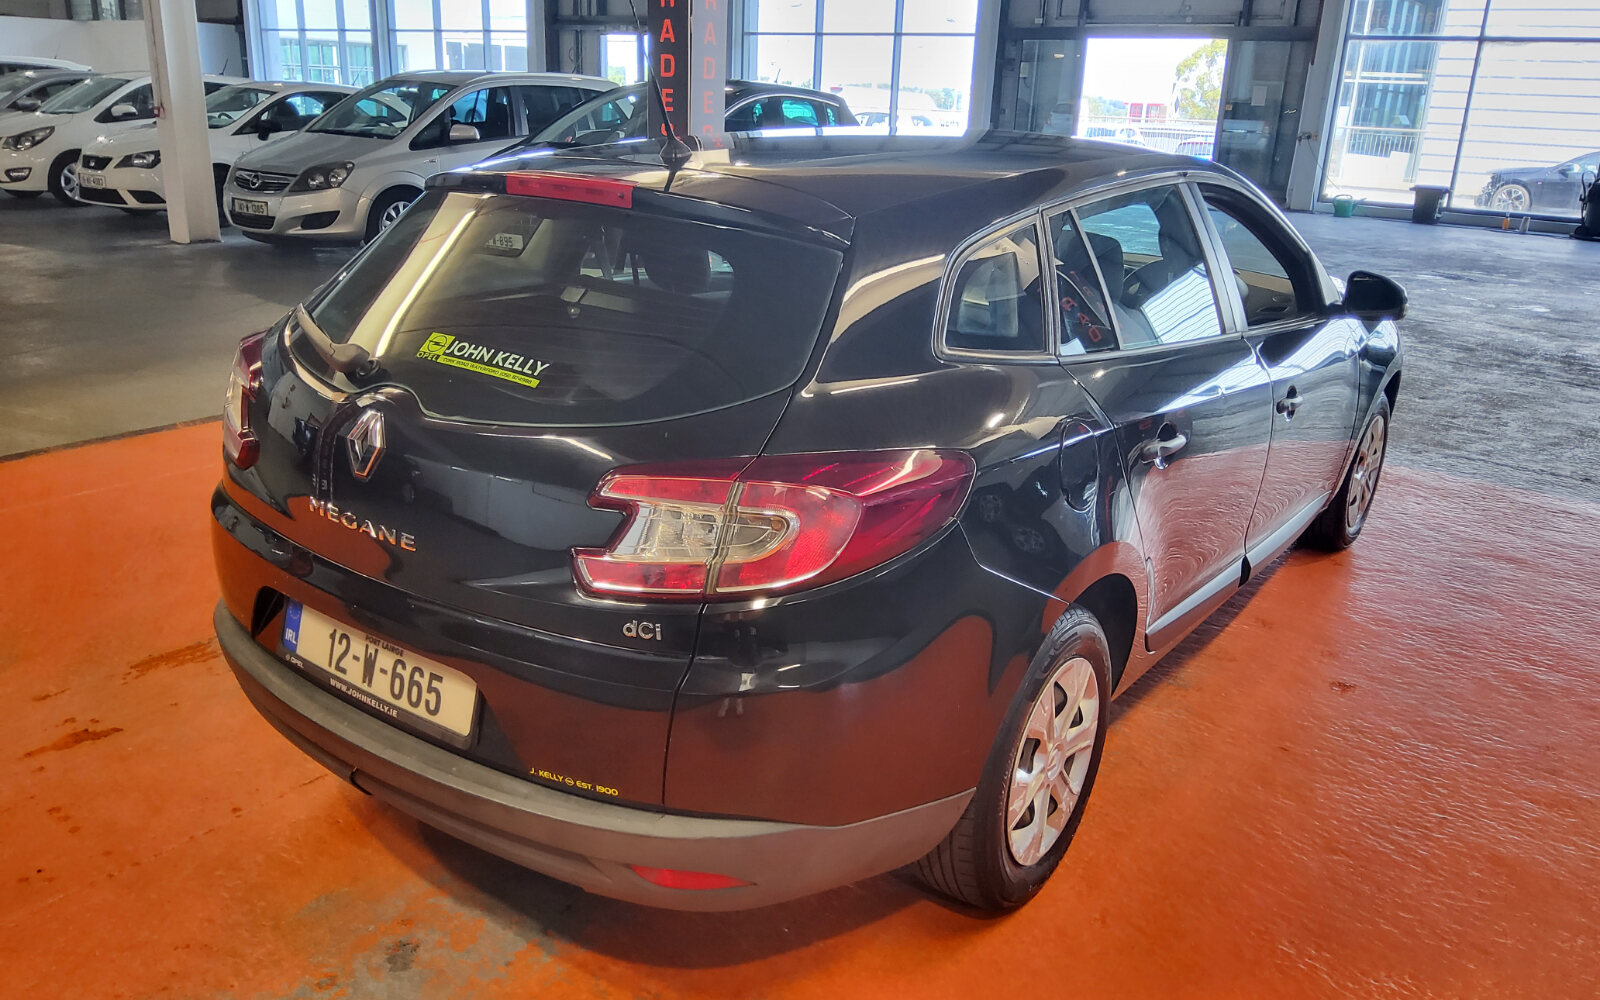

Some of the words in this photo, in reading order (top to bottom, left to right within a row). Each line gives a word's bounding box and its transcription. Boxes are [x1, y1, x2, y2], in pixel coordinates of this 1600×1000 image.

[416, 351, 438, 361] OPEL
[445, 341, 495, 363] JOHN
[493, 351, 550, 376] KELLY
[309, 496, 416, 552] MEGANE
[285, 628, 297, 644] IRL
[622, 619, 662, 641] dCi
[328, 628, 444, 716] 12-W-665
[329, 677, 398, 718] WWW.JOHNKELLY.IE
[529, 767, 538, 775] J.
[538, 769, 564, 783] KELLY
[576, 780, 594, 791] EST.
[596, 785, 619, 796] 1900
